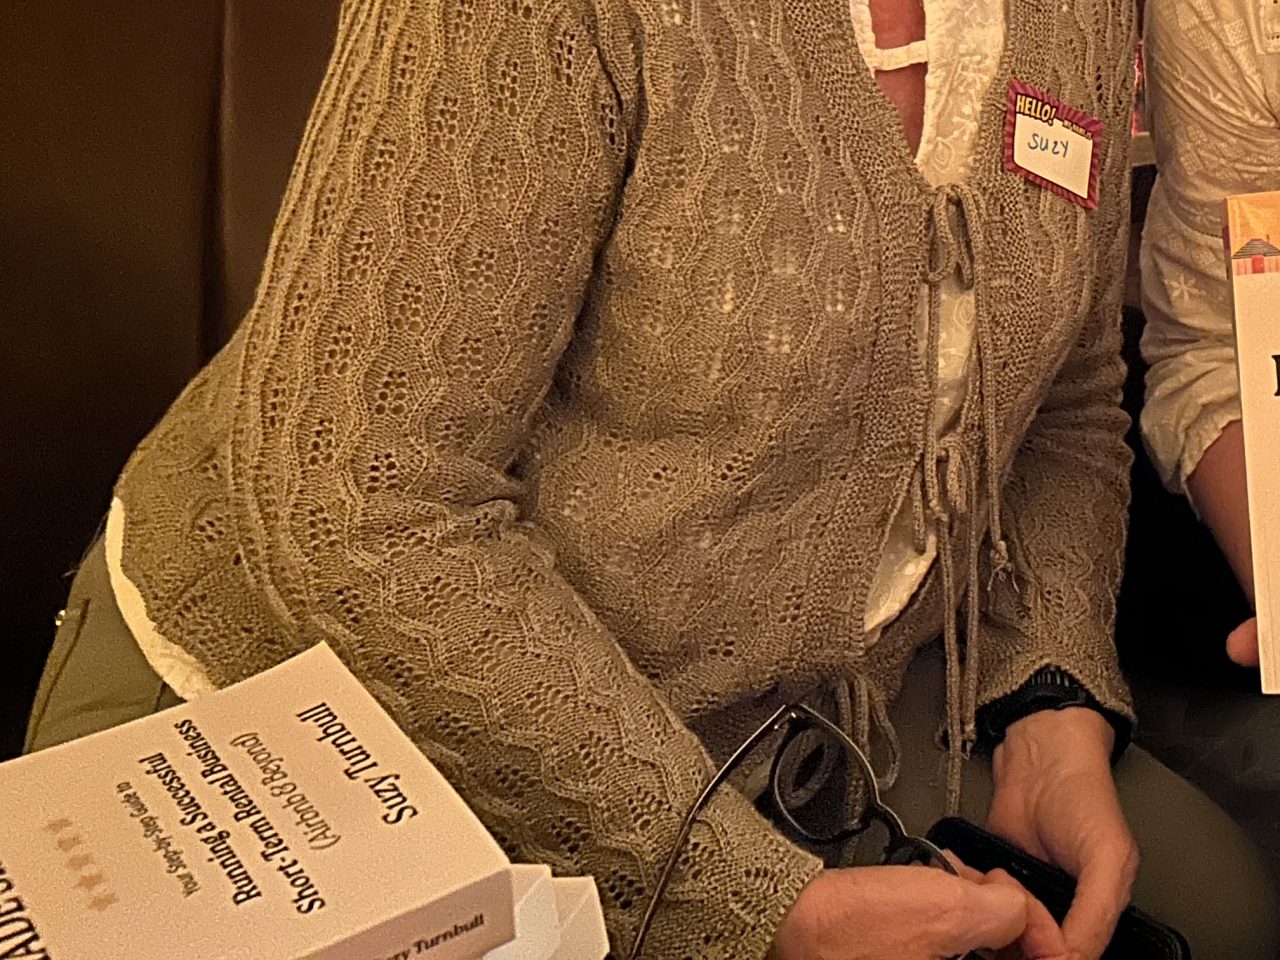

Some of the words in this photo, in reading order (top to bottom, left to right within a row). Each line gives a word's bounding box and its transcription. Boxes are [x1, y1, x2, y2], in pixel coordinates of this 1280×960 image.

[1016, 94, 1057, 126] HELLO!
[174, 718, 228, 779] Business
[230, 732, 288, 786] Beyond)
[296, 702, 378, 781] Turnbull
[121, 791, 149, 818] Guide
[138, 752, 209, 826] Successful
[207, 773, 256, 823] Rental
[270, 782, 297, 798] &
[364, 773, 419, 825] Suzy
[196, 821, 217, 835] a
[282, 794, 342, 850] (Airbnb
[200, 830, 262, 906] Running
[250, 816, 326, 914] Short-Term
[413, 913, 485, 954] Turnbull
